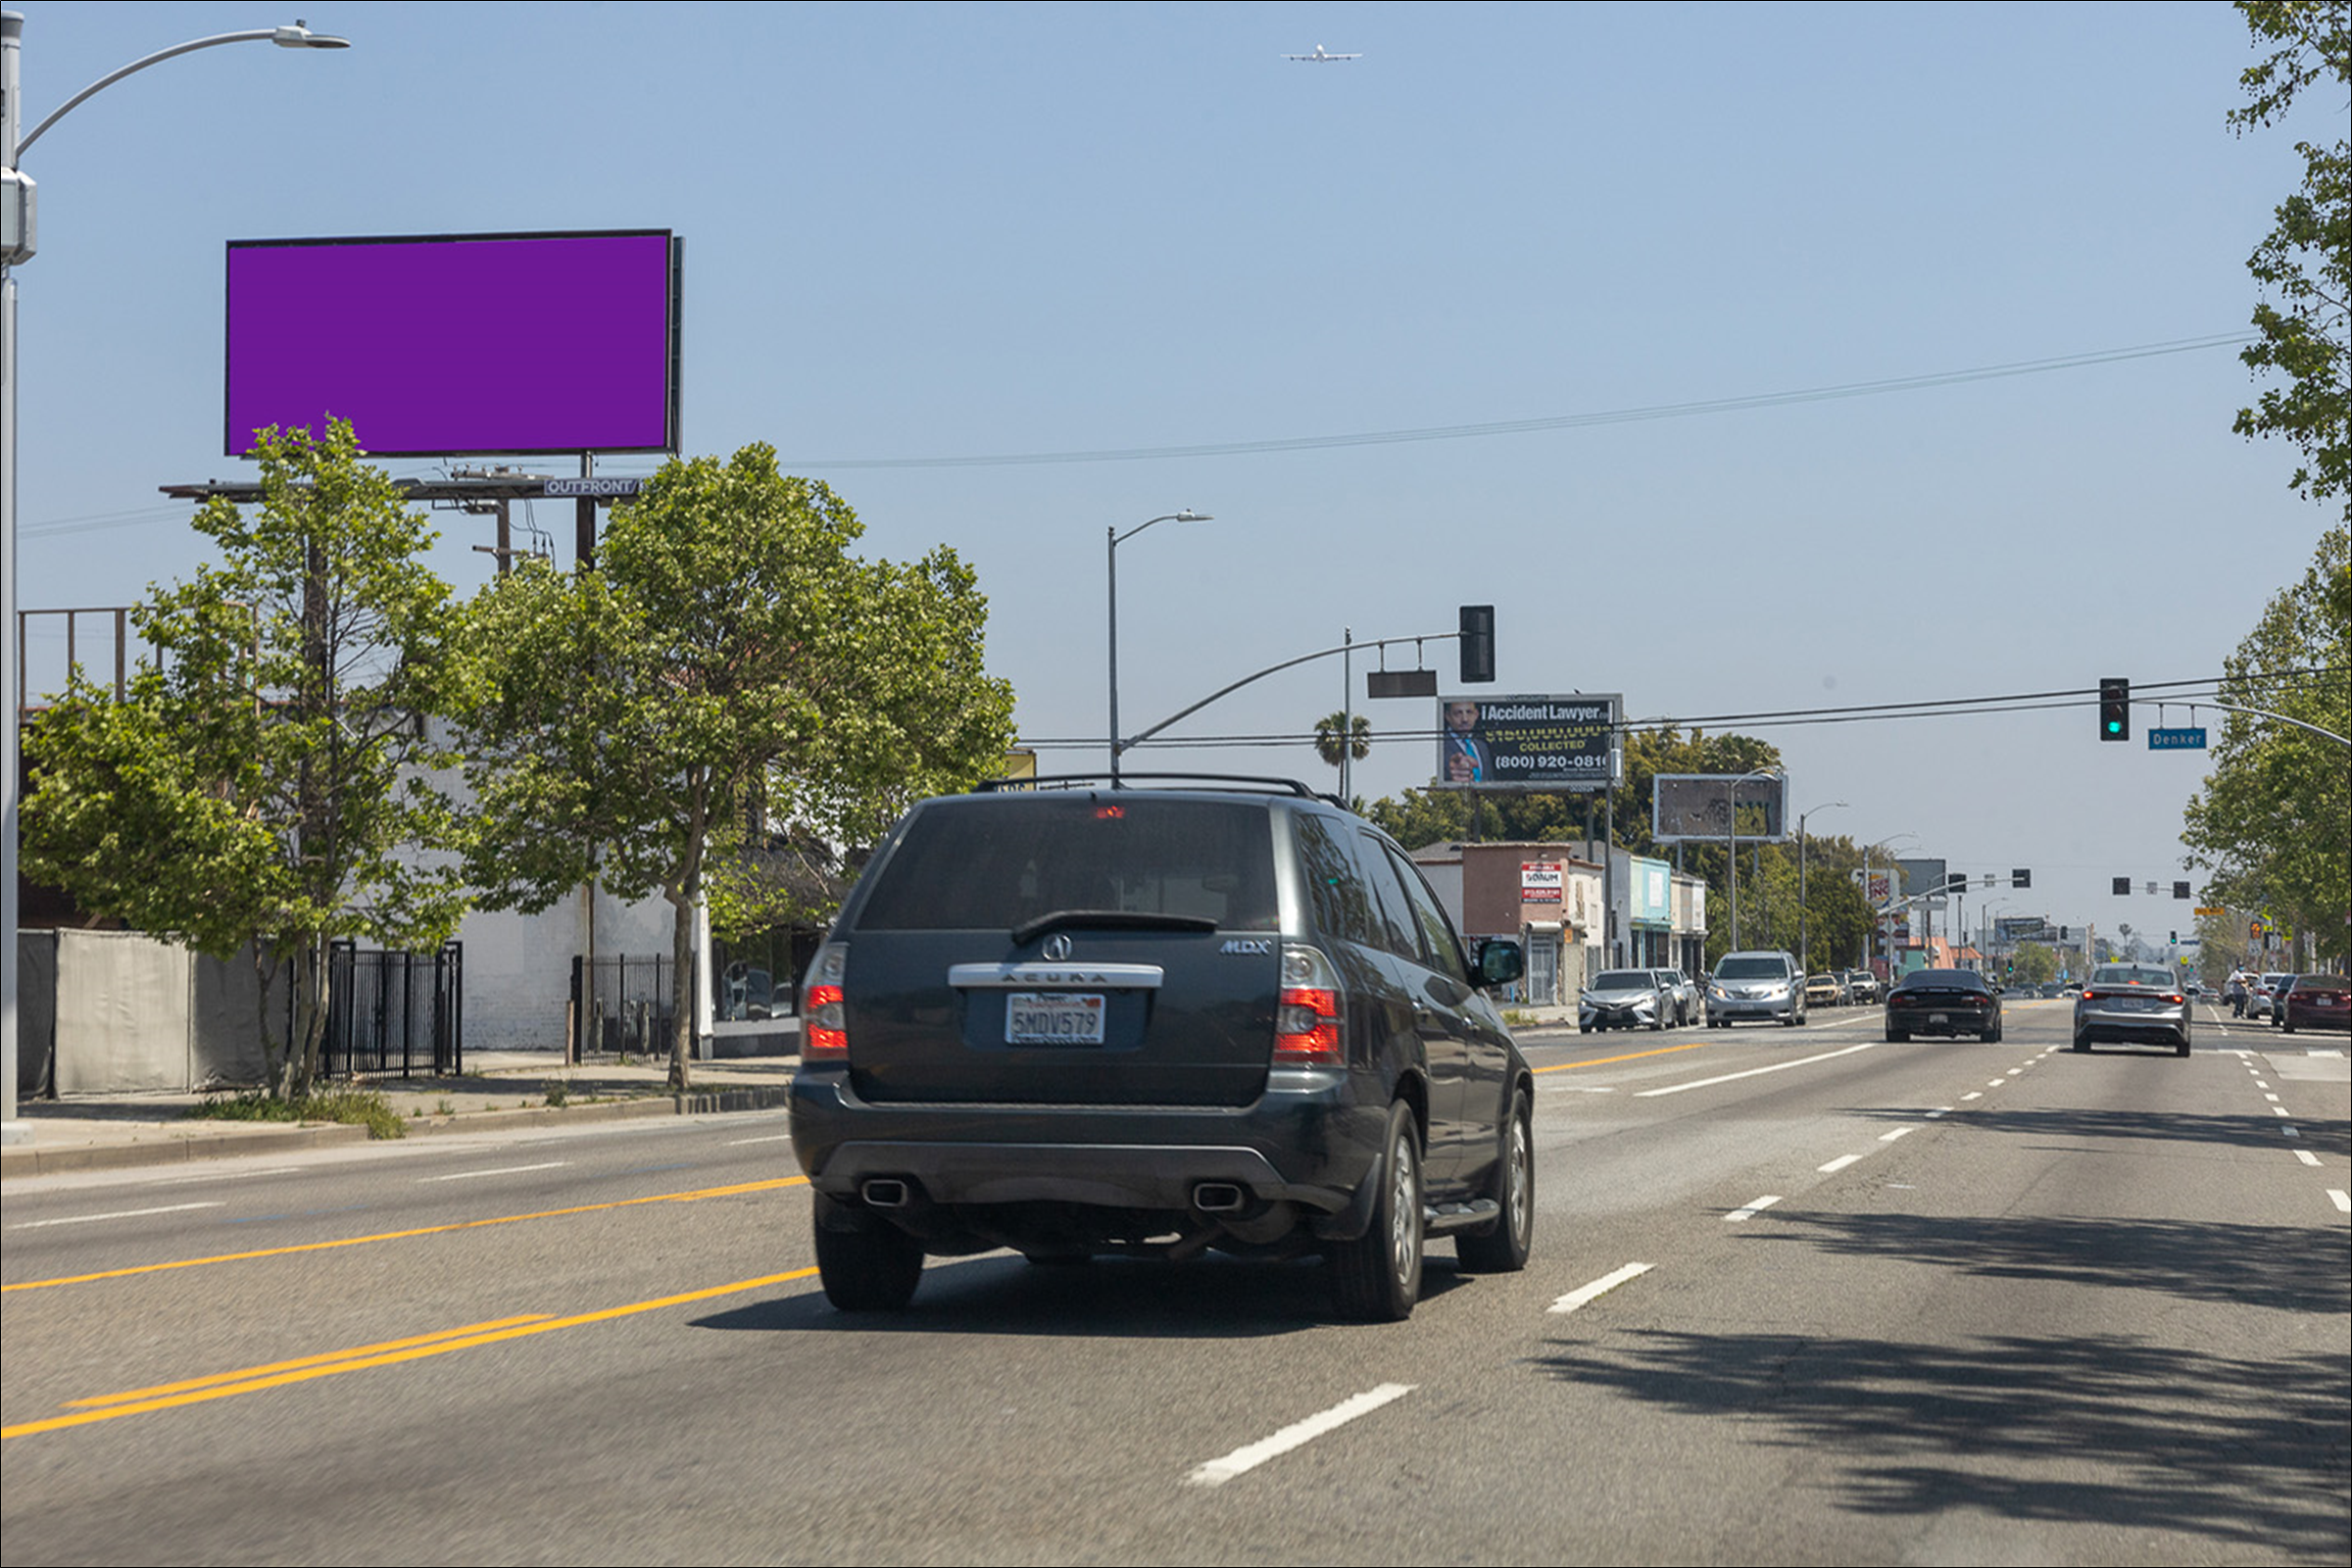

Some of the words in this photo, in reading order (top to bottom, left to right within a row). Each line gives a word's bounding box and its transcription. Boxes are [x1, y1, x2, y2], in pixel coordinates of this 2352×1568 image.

[549, 480, 633, 493] OUTFRONT
[1488, 705, 1547, 720] Accident
[2153, 733, 2201, 745] Denker
[1519, 740, 1586, 753] COLLECTED
[1494, 755, 1535, 769] (800)
[1220, 939, 1271, 955] MDX
[1002, 972, 1108, 983] ACURA
[1013, 1011, 1098, 1035] 5MDV579
